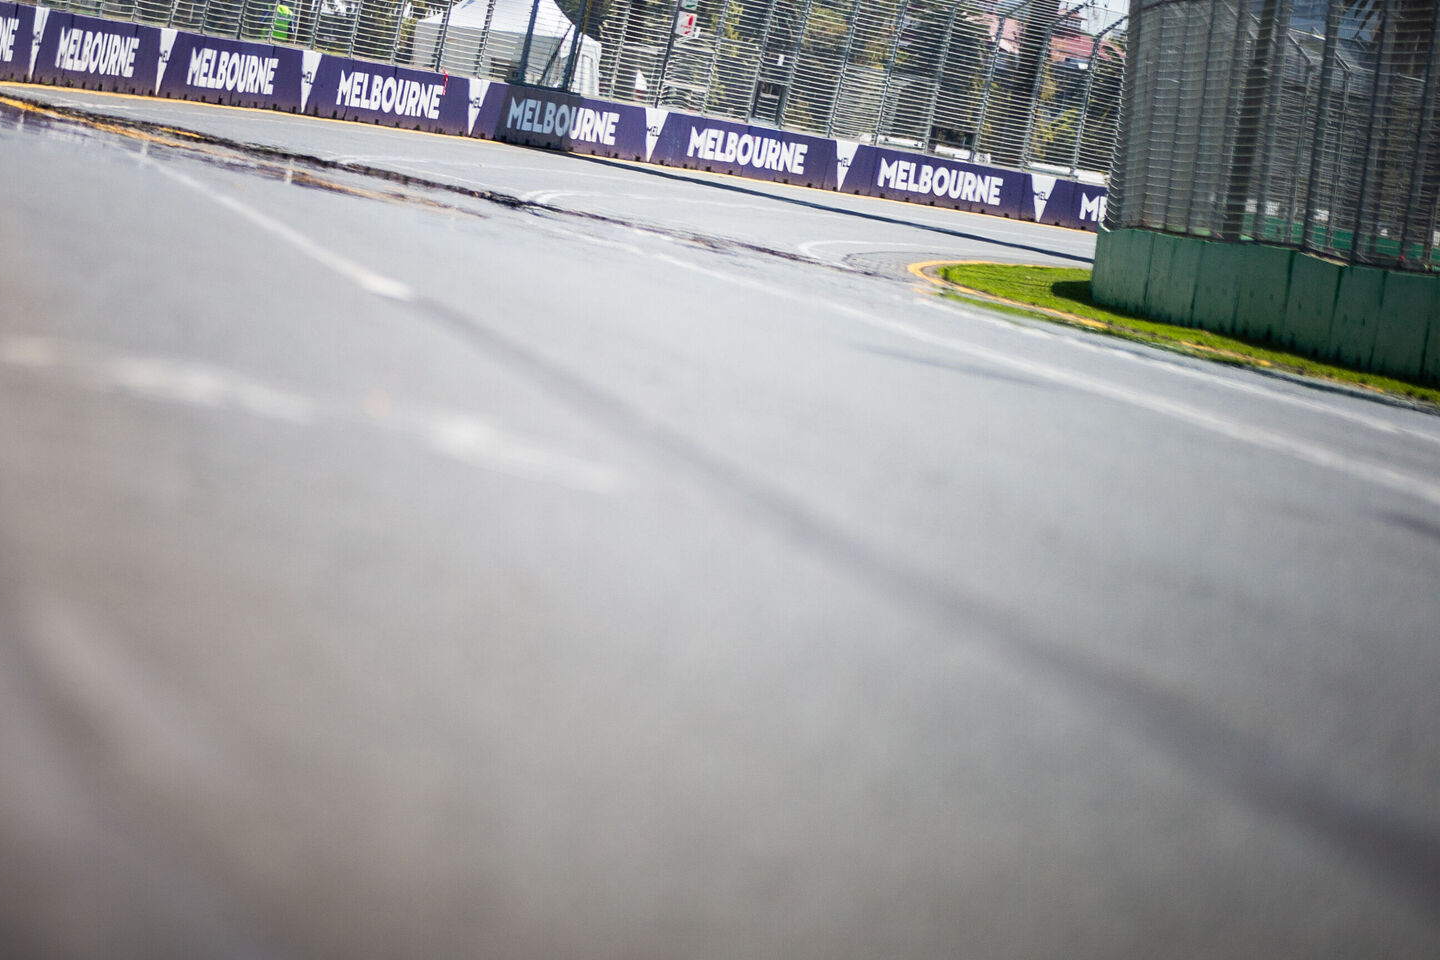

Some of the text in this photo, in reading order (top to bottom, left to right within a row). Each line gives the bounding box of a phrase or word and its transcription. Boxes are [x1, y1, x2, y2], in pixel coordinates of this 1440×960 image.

[55, 25, 140, 78] MELBOURNE
[186, 46, 279, 95] MELBOURNE
[335, 70, 444, 120] MELBOURNE
[506, 96, 620, 146] MELBOURNE
[686, 126, 808, 175] MELBOURNE
[877, 157, 1004, 206] MELBOURNE
